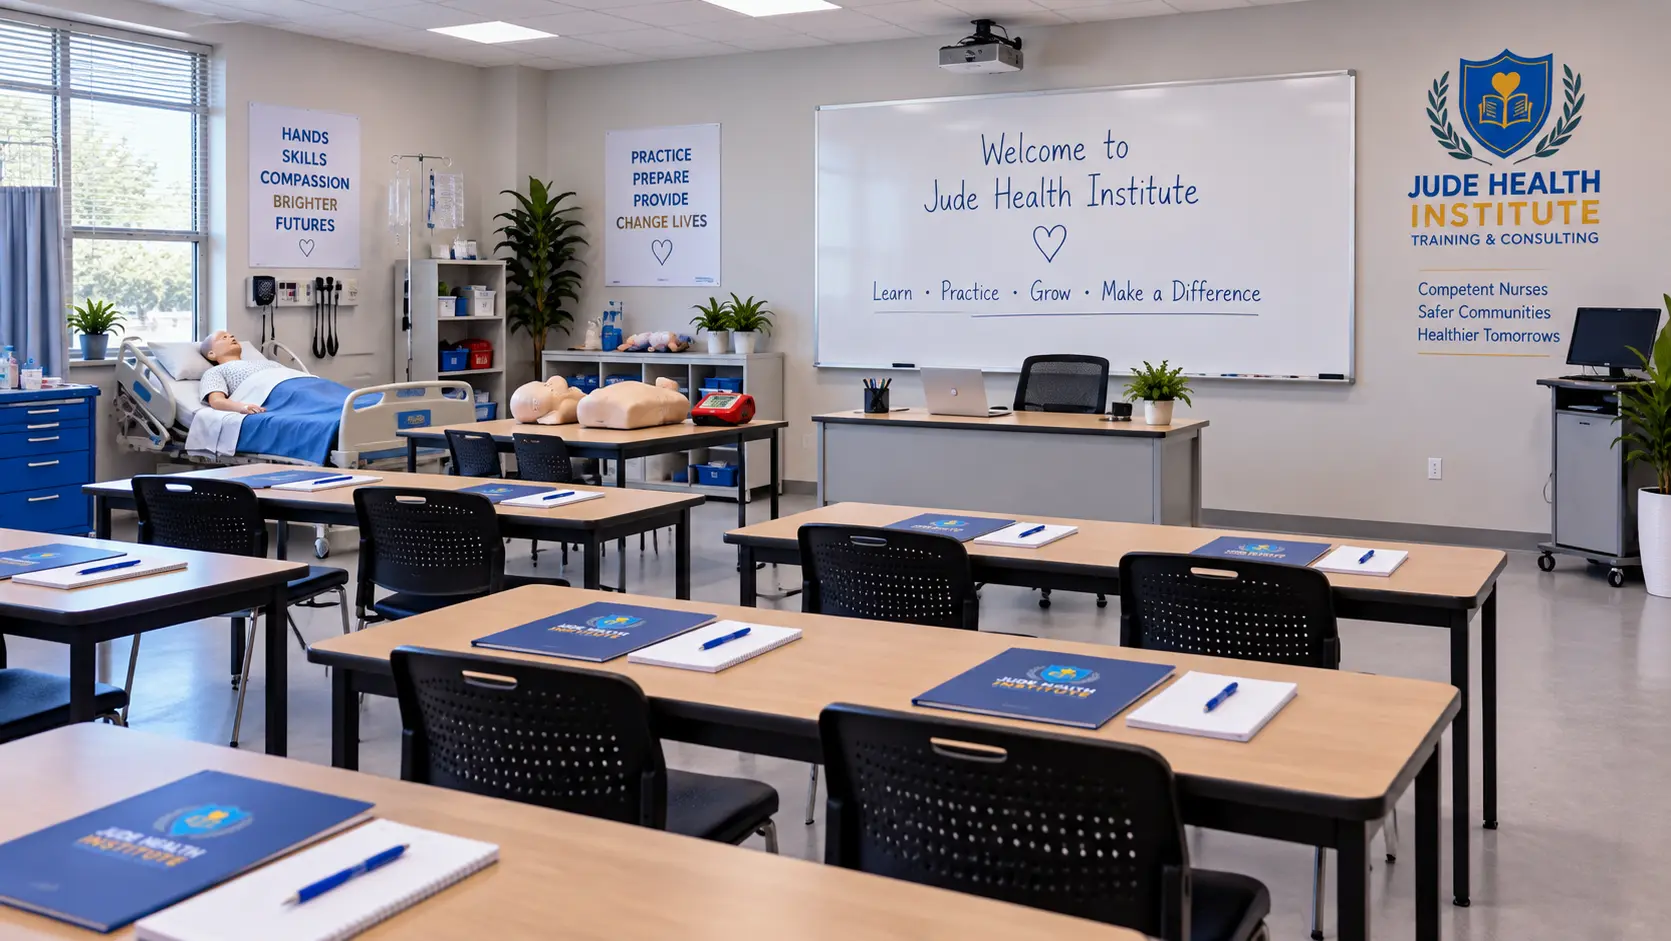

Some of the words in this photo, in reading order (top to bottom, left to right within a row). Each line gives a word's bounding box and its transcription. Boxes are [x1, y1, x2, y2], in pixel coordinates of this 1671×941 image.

[282, 126, 330, 145] HANDS
[631, 147, 692, 165] PRACTICE
[981, 131, 1086, 166] Welcome
[1103, 129, 1129, 160] to
[282, 148, 327, 167] SKILLS
[260, 170, 350, 190] COMPASSION
[632, 169, 690, 186] PREPARE
[1407, 173, 1479, 199] JUDE
[1488, 169, 1601, 196] HEALTH
[633, 192, 689, 208] PROVIDE
[923, 178, 979, 213] Jude
[994, 175, 1072, 210] Health
[1086, 172, 1199, 207] Institute
[273, 194, 338, 212] BRIGHTER
[615, 215, 669, 230] CHANGE
[672, 213, 708, 228] LIVES
[1411, 199, 1600, 229] INSTITUTE
[275, 216, 336, 233] FUTURES
[1411, 233, 1481, 247] TRAINING
[1485, 233, 1496, 246] &
[1500, 231, 1599, 245] CONSULTING
[873, 280, 913, 301] Learn
[941, 279, 1000, 301] Practice
[1030, 279, 1071, 302] Grow
[1101, 279, 1144, 302] Make
[1152, 288, 1164, 303] a
[1172, 279, 1261, 302] Difference
[1418, 281, 1495, 300] Competent
[1499, 281, 1549, 296] Nurses
[1418, 304, 1455, 319] Safer
[1458, 304, 1552, 320] Communities
[1418, 326, 1480, 342] Healthier
[1483, 327, 1561, 343] Tomorrows
